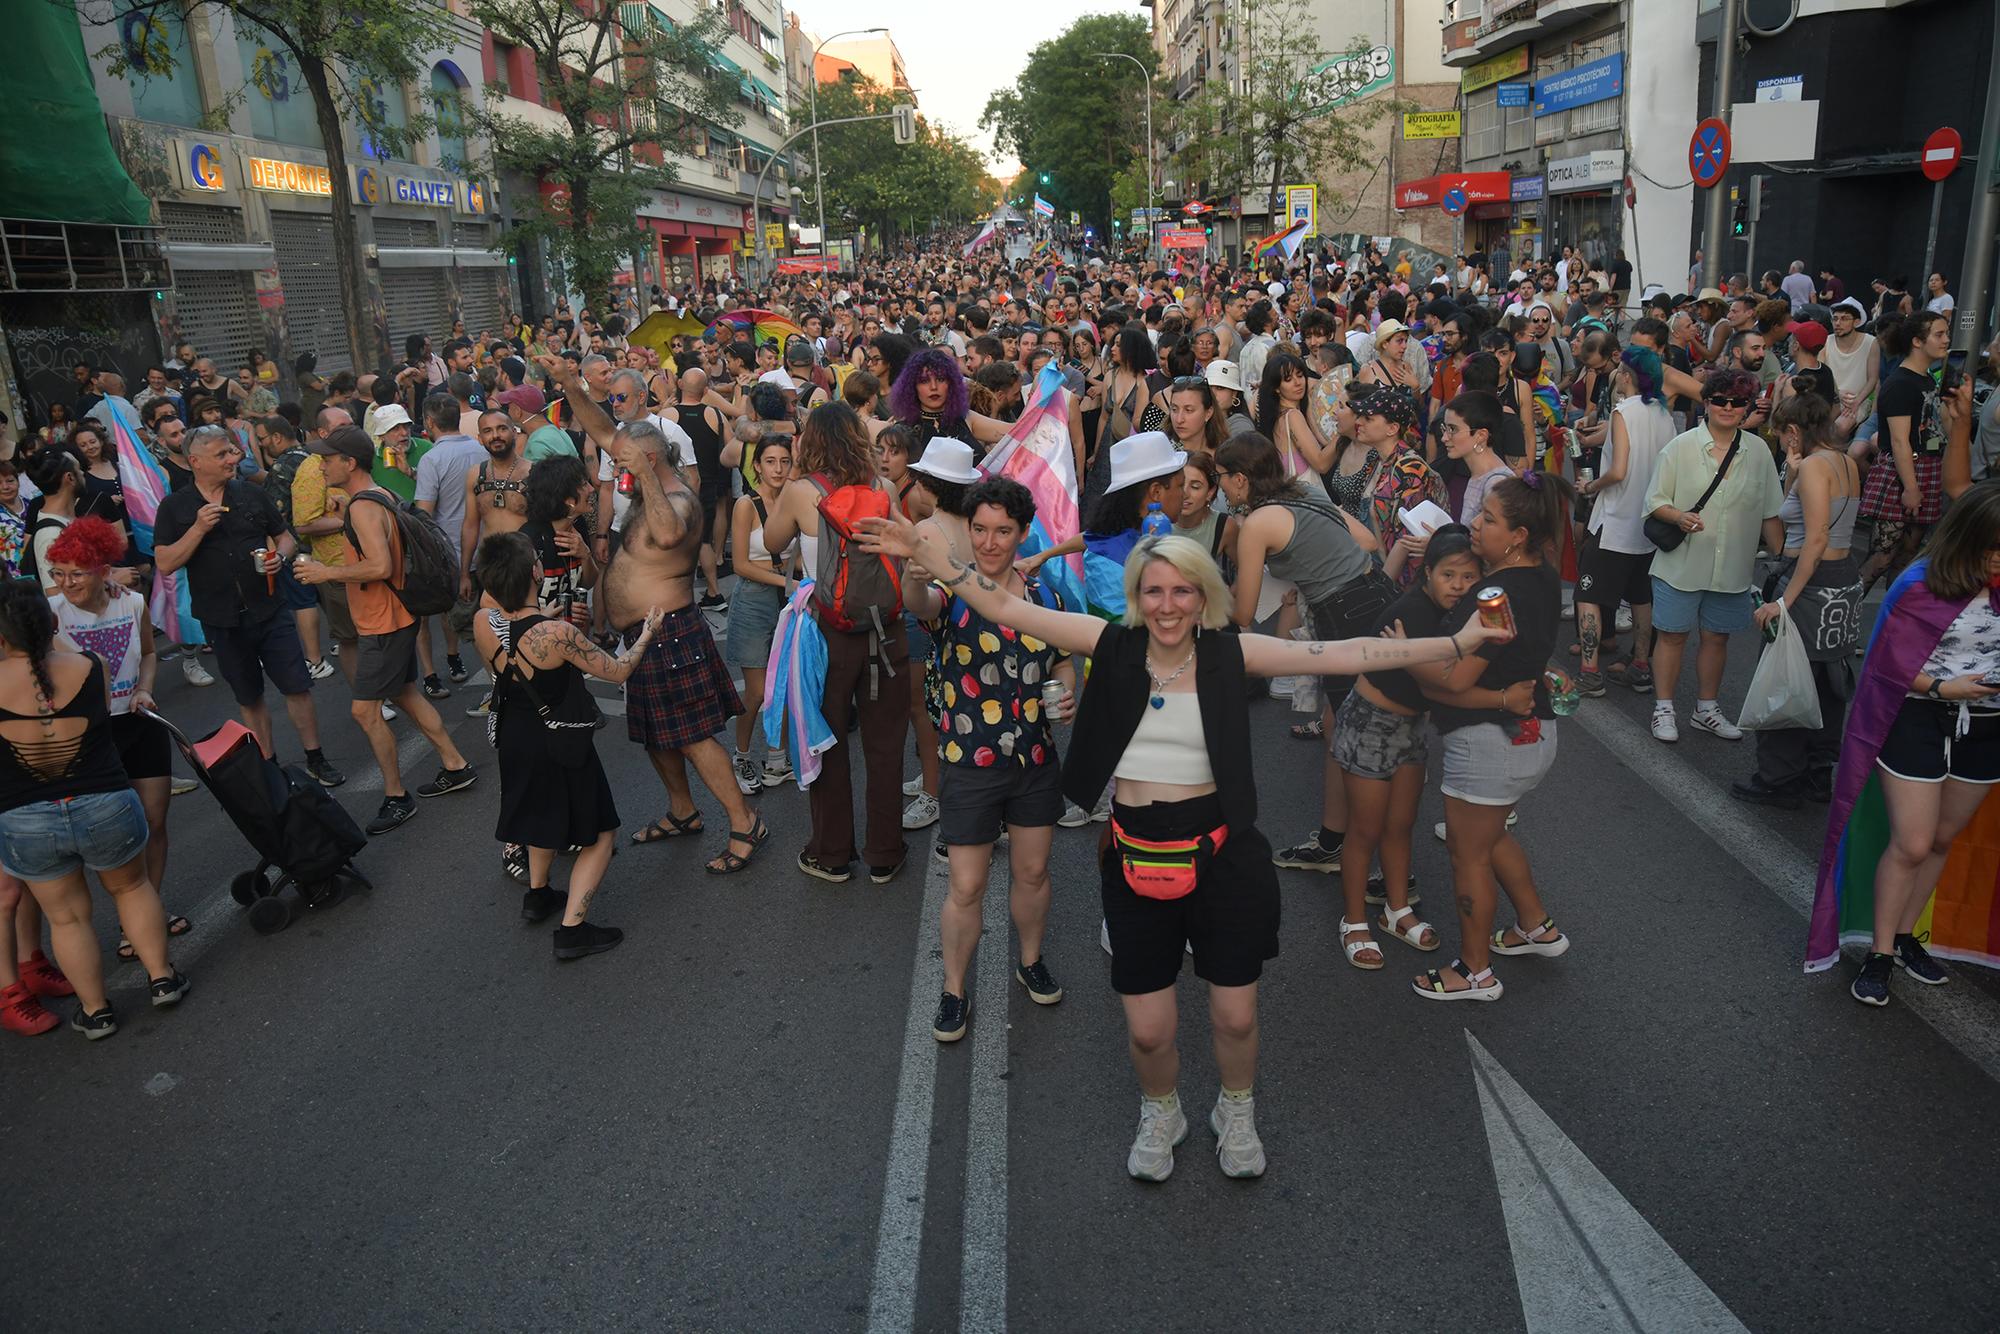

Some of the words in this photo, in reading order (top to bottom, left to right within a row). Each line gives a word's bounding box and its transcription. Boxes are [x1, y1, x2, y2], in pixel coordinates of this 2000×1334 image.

[1758, 75, 1803, 87] DISPONIBLE
[1549, 167, 1573, 182] OPTICA
[397, 178, 454, 204] GALVEZ
